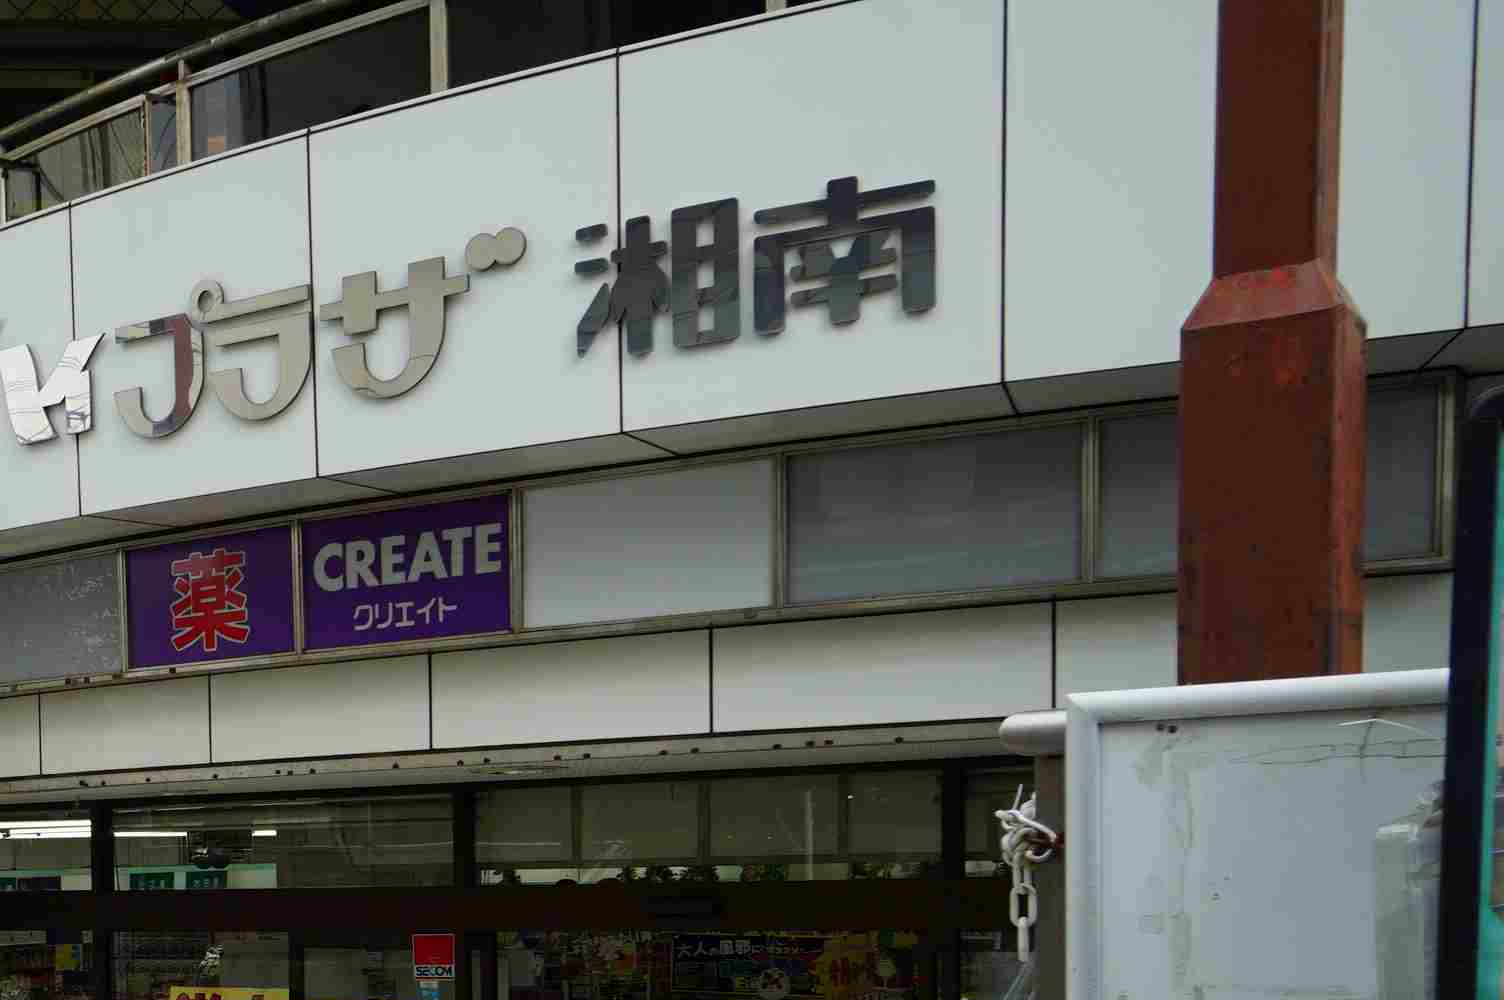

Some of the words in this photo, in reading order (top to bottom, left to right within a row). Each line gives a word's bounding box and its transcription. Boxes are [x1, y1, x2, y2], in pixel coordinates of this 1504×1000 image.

[573, 175, 937, 357] 湘南
[312, 522, 503, 593] CREATE
[170, 547, 252, 653] 薬
[352, 597, 459, 632] クリエイト
[415, 965, 453, 978] SECOM
